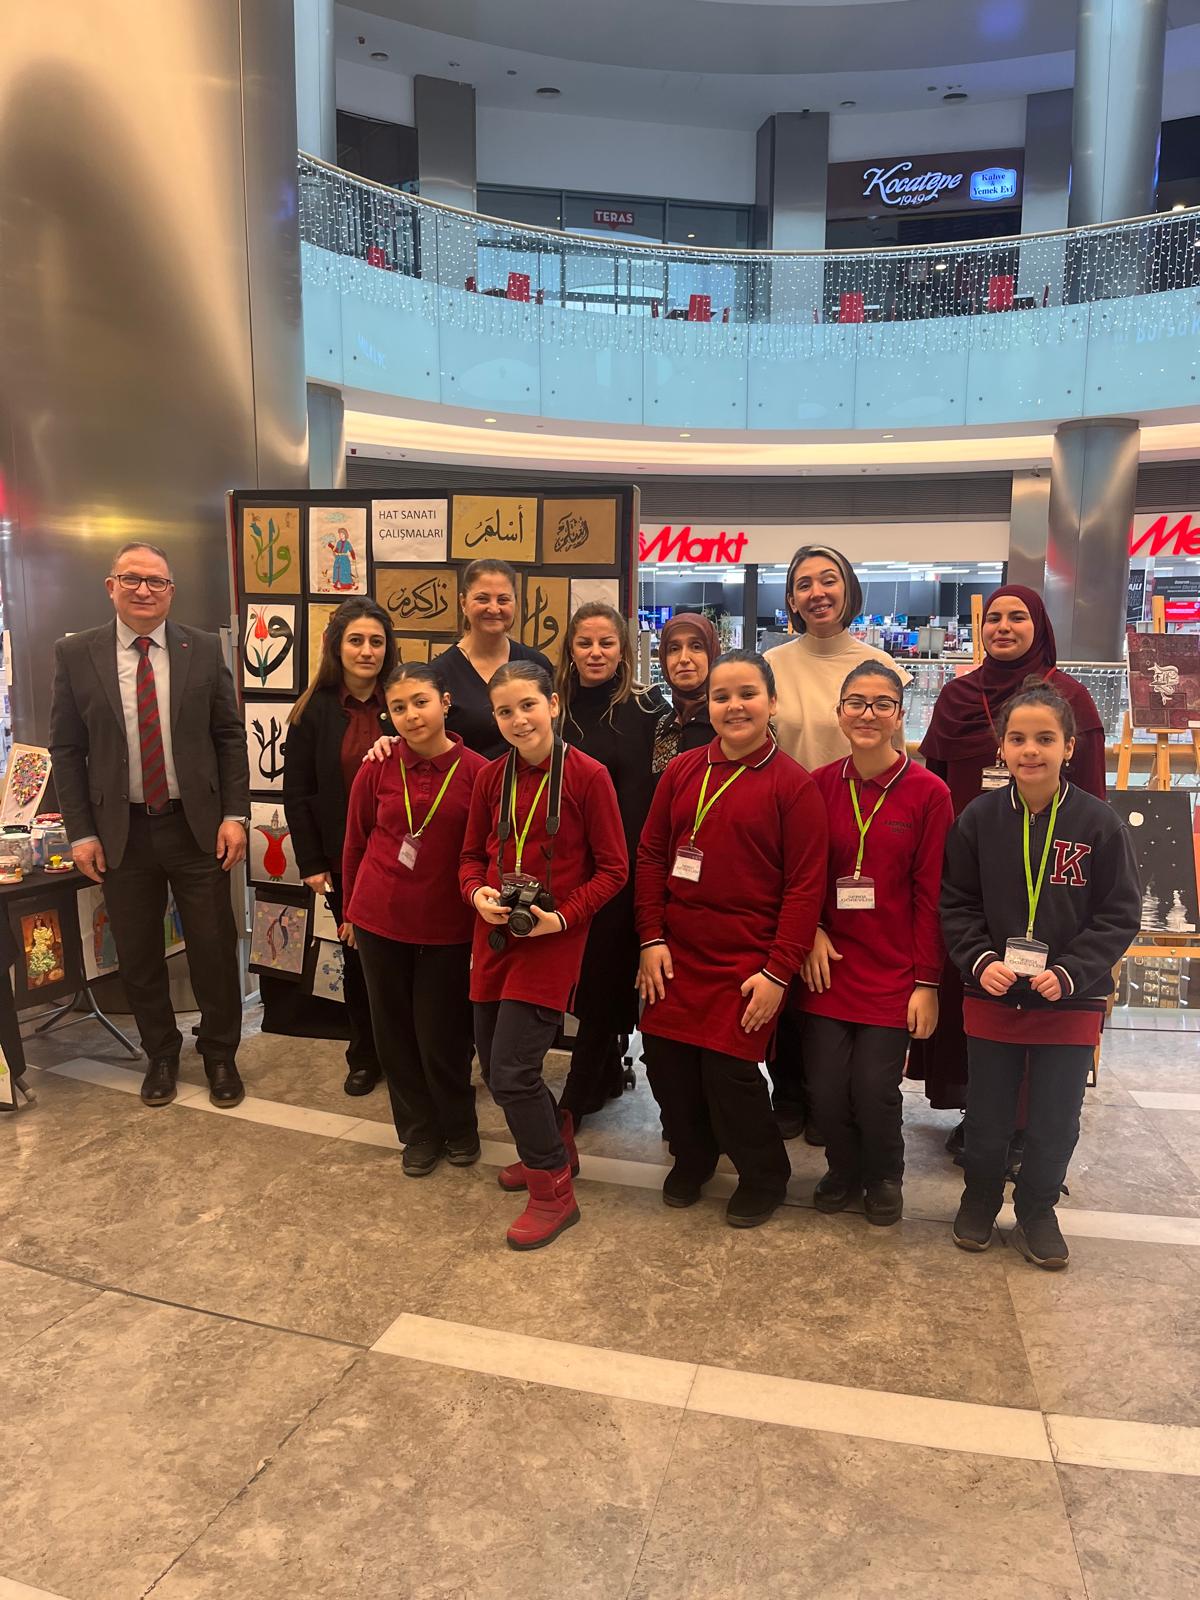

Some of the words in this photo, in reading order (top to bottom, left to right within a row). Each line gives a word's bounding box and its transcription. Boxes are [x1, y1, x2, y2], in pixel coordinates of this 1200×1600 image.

[863, 162, 963, 204] Kocatepe
[973, 186, 998, 195] Yemek
[899, 194, 925, 206] 1949
[595, 211, 633, 223] TERAS
[379, 510, 398, 520] HAT
[401, 510, 437, 520] SANATI
[379, 529, 444, 541] ÇALIŞMALARI
[639, 525, 749, 563] Markt
[1050, 840, 1091, 886] K
